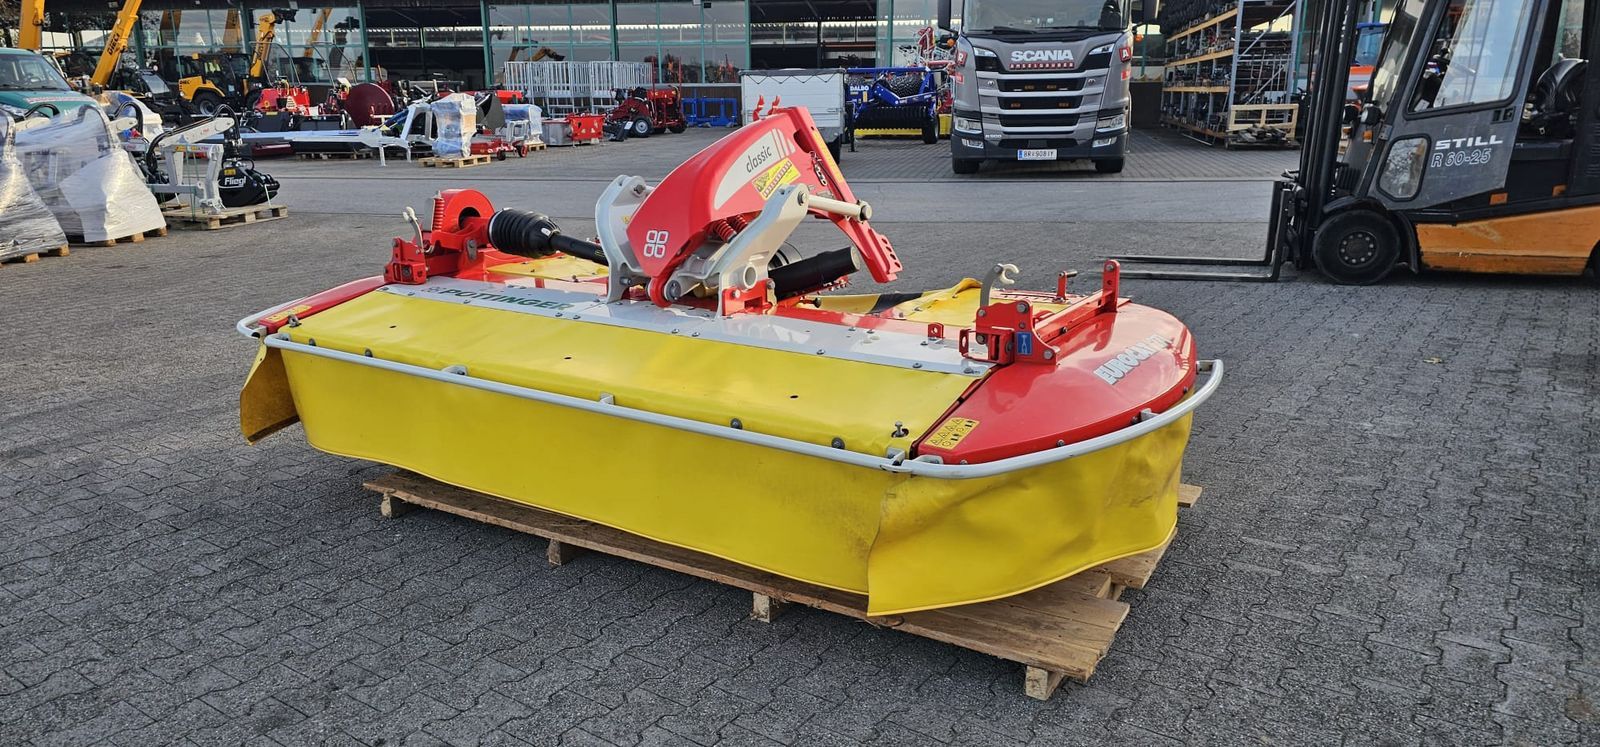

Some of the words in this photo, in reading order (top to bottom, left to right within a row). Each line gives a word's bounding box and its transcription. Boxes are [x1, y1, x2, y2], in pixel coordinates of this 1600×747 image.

[1011, 49, 1074, 62] SCANIA
[1436, 135, 1502, 149] STILL
[745, 145, 772, 173] classic
[1431, 152, 1443, 167] R
[1445, 149, 1491, 166] 60-25
[224, 176, 247, 187] Fliegl
